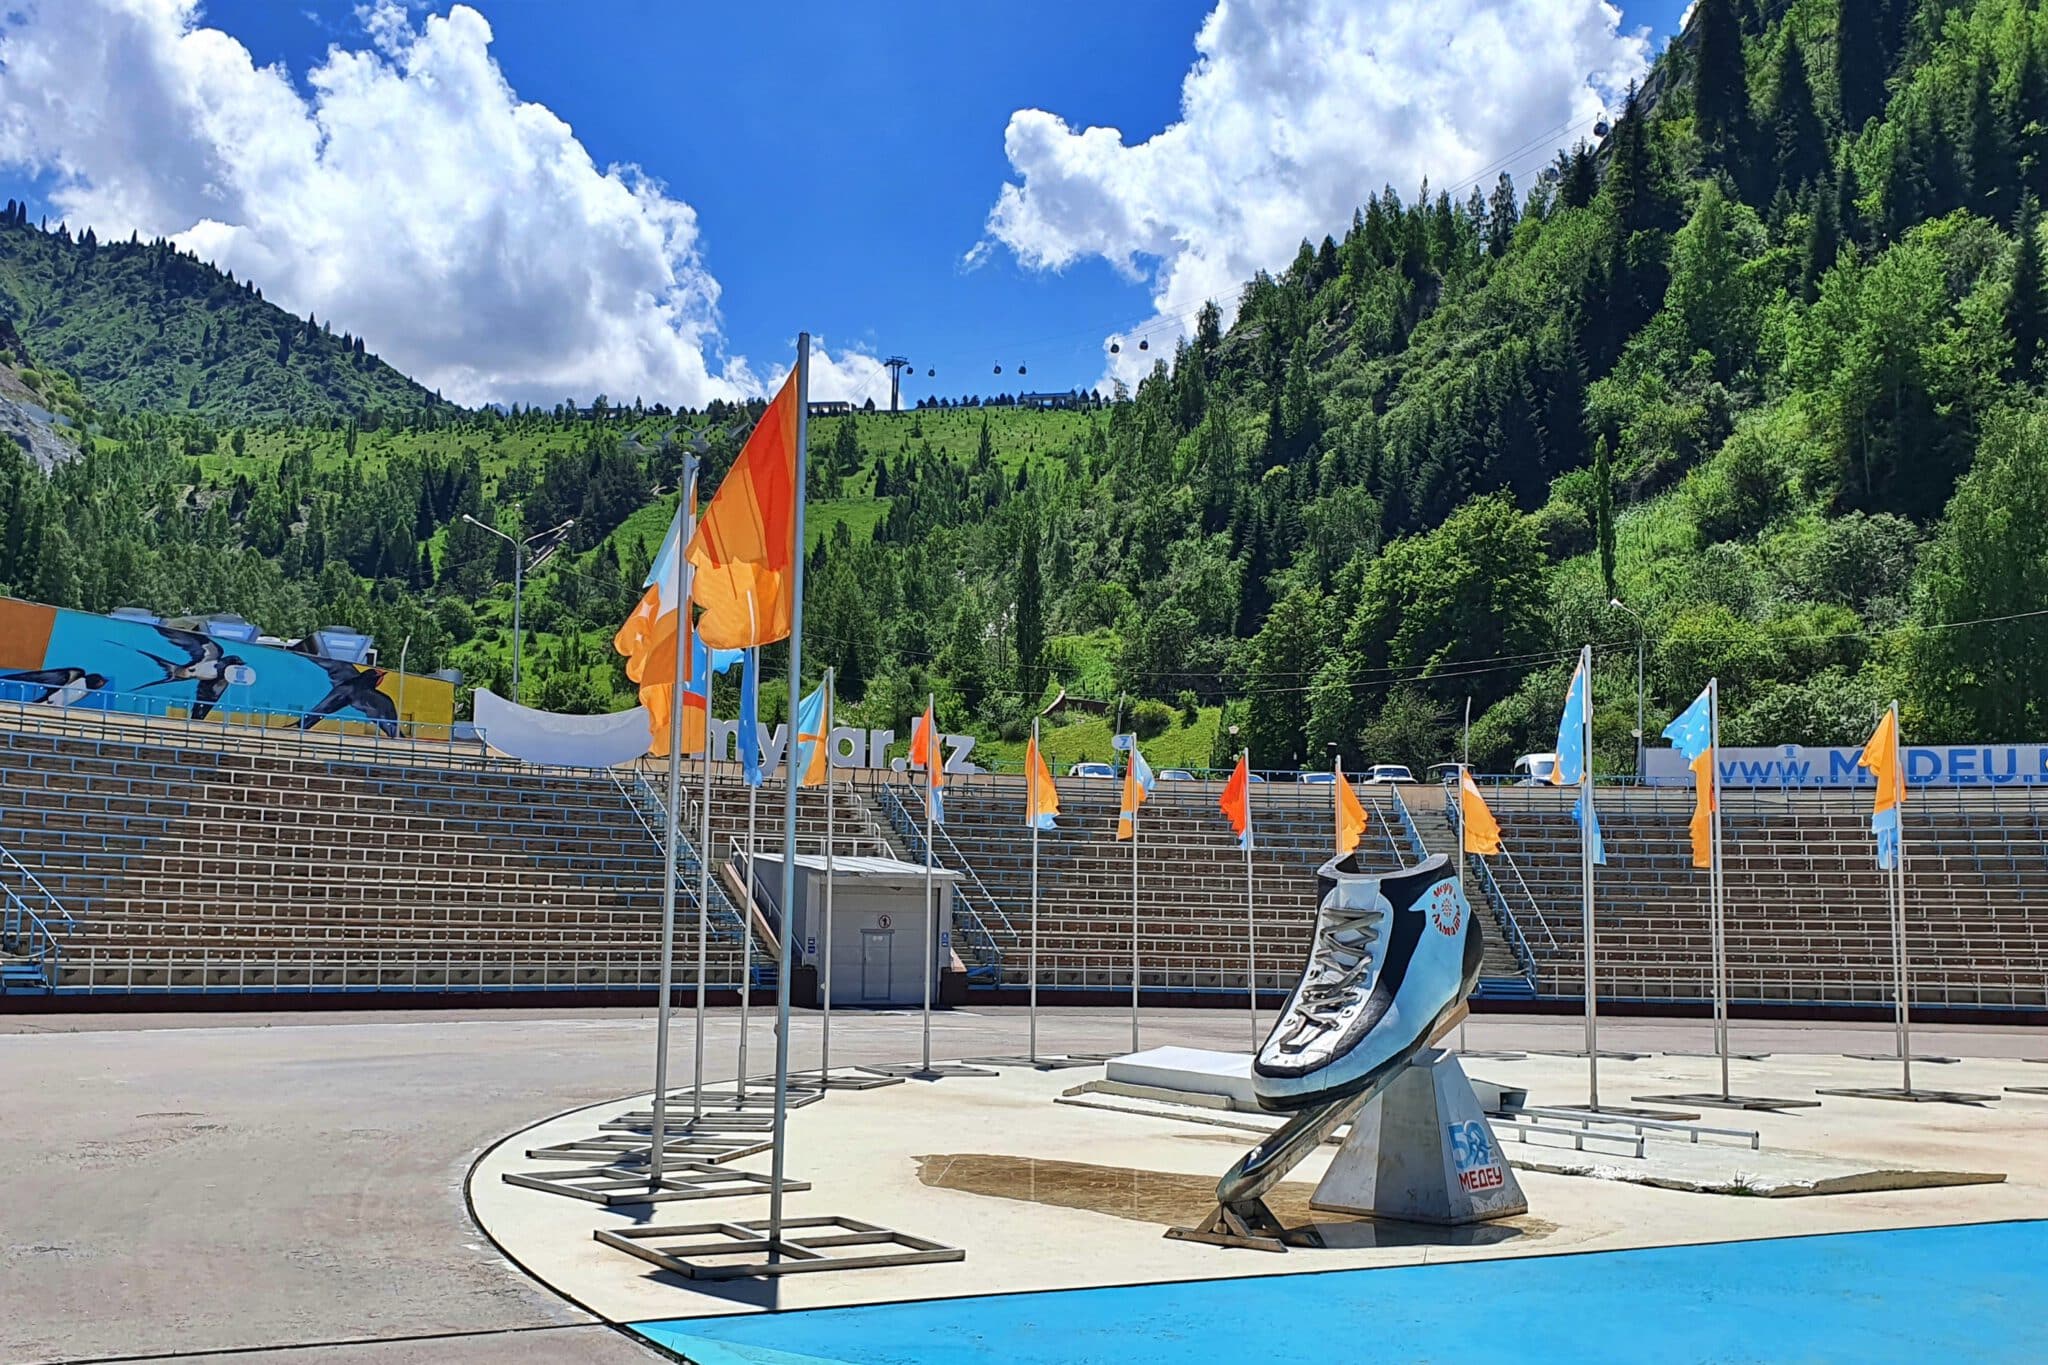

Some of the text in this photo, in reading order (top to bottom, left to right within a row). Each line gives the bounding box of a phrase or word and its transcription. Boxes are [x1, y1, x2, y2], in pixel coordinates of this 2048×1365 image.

[690, 717, 975, 776] myar.z
[1719, 748, 2048, 784] www.MDEU.
[1448, 1120, 1490, 1169] 50
[1458, 1166, 1503, 1192] МЕДЕУ
